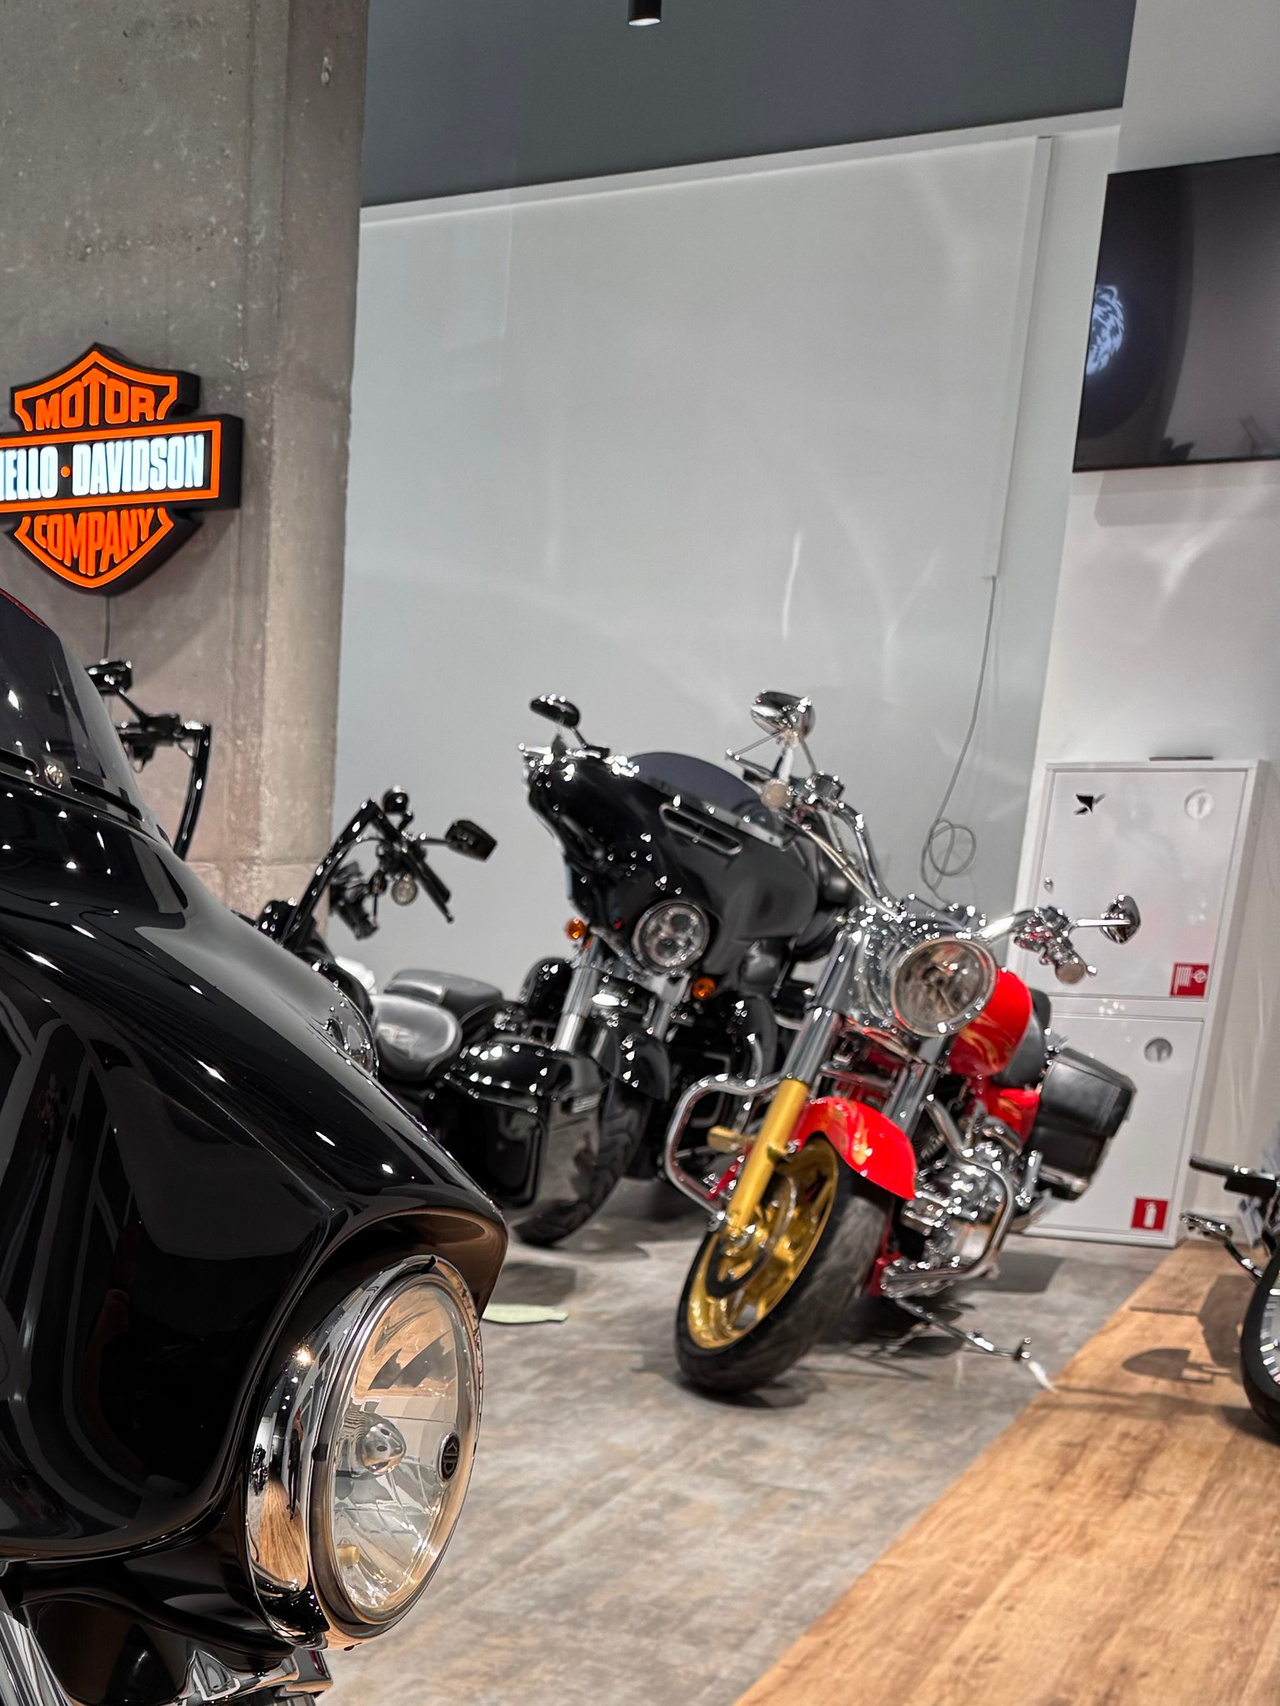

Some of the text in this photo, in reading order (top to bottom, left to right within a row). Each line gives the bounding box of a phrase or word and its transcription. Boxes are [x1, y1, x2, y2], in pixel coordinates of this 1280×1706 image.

[35, 367, 156, 430] MOTOR
[72, 433, 205, 496] DAVIDSON
[33, 507, 155, 577] COMPANY
